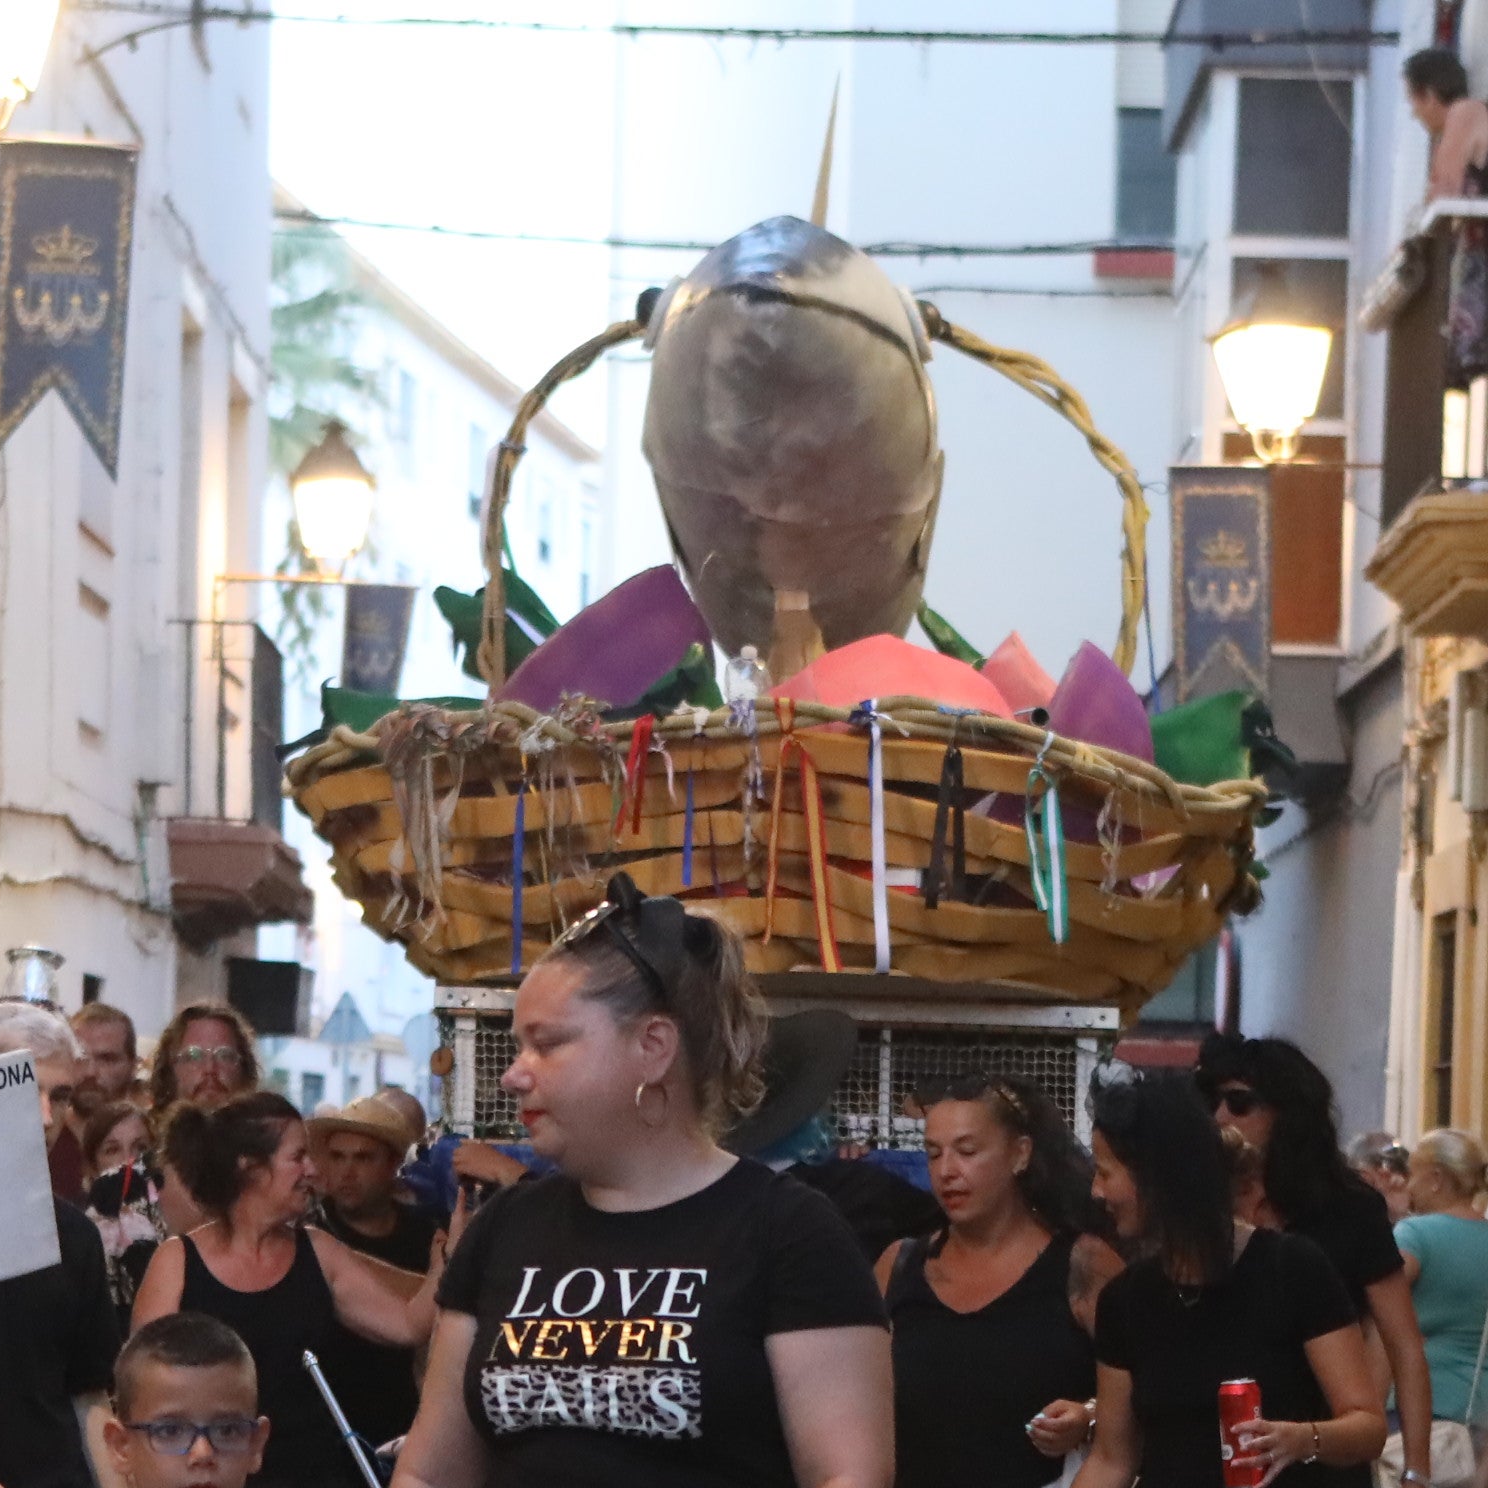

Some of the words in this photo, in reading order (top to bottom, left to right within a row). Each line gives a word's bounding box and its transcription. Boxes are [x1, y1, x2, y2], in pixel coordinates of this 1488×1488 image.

[505, 1266, 708, 1320] LOVE
[487, 1319, 698, 1364] NEVER
[494, 1373, 690, 1433] FAILS
